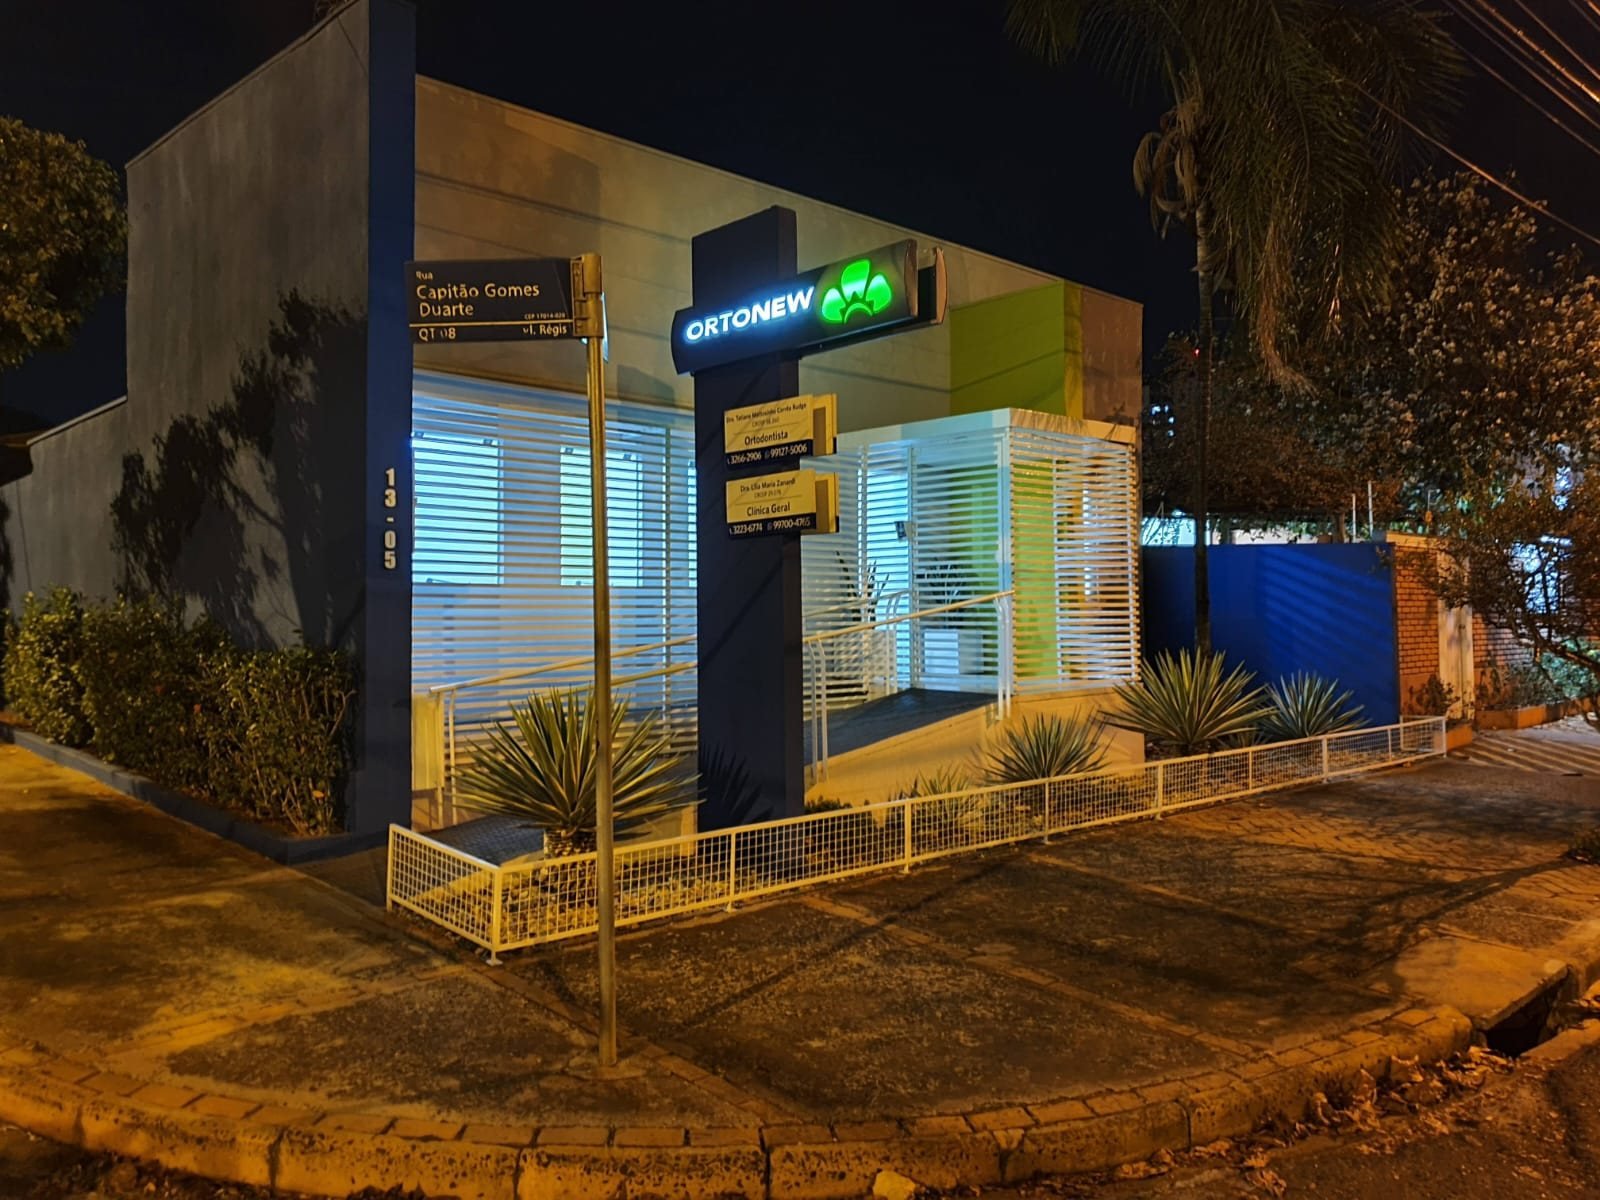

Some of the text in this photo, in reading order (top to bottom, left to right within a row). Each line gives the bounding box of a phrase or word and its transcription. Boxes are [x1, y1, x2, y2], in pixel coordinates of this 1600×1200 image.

[416, 283, 540, 300] Capitão Gomes
[419, 302, 474, 317] Duarte
[686, 287, 814, 341] ORTONEW
[419, 328, 435, 341] QT
[539, 323, 567, 337] Régis
[744, 431, 789, 446] Ortodontista
[770, 444, 808, 459] 99127-5006
[770, 502, 791, 513] Geral
[384, 468, 397, 569] 13-05
